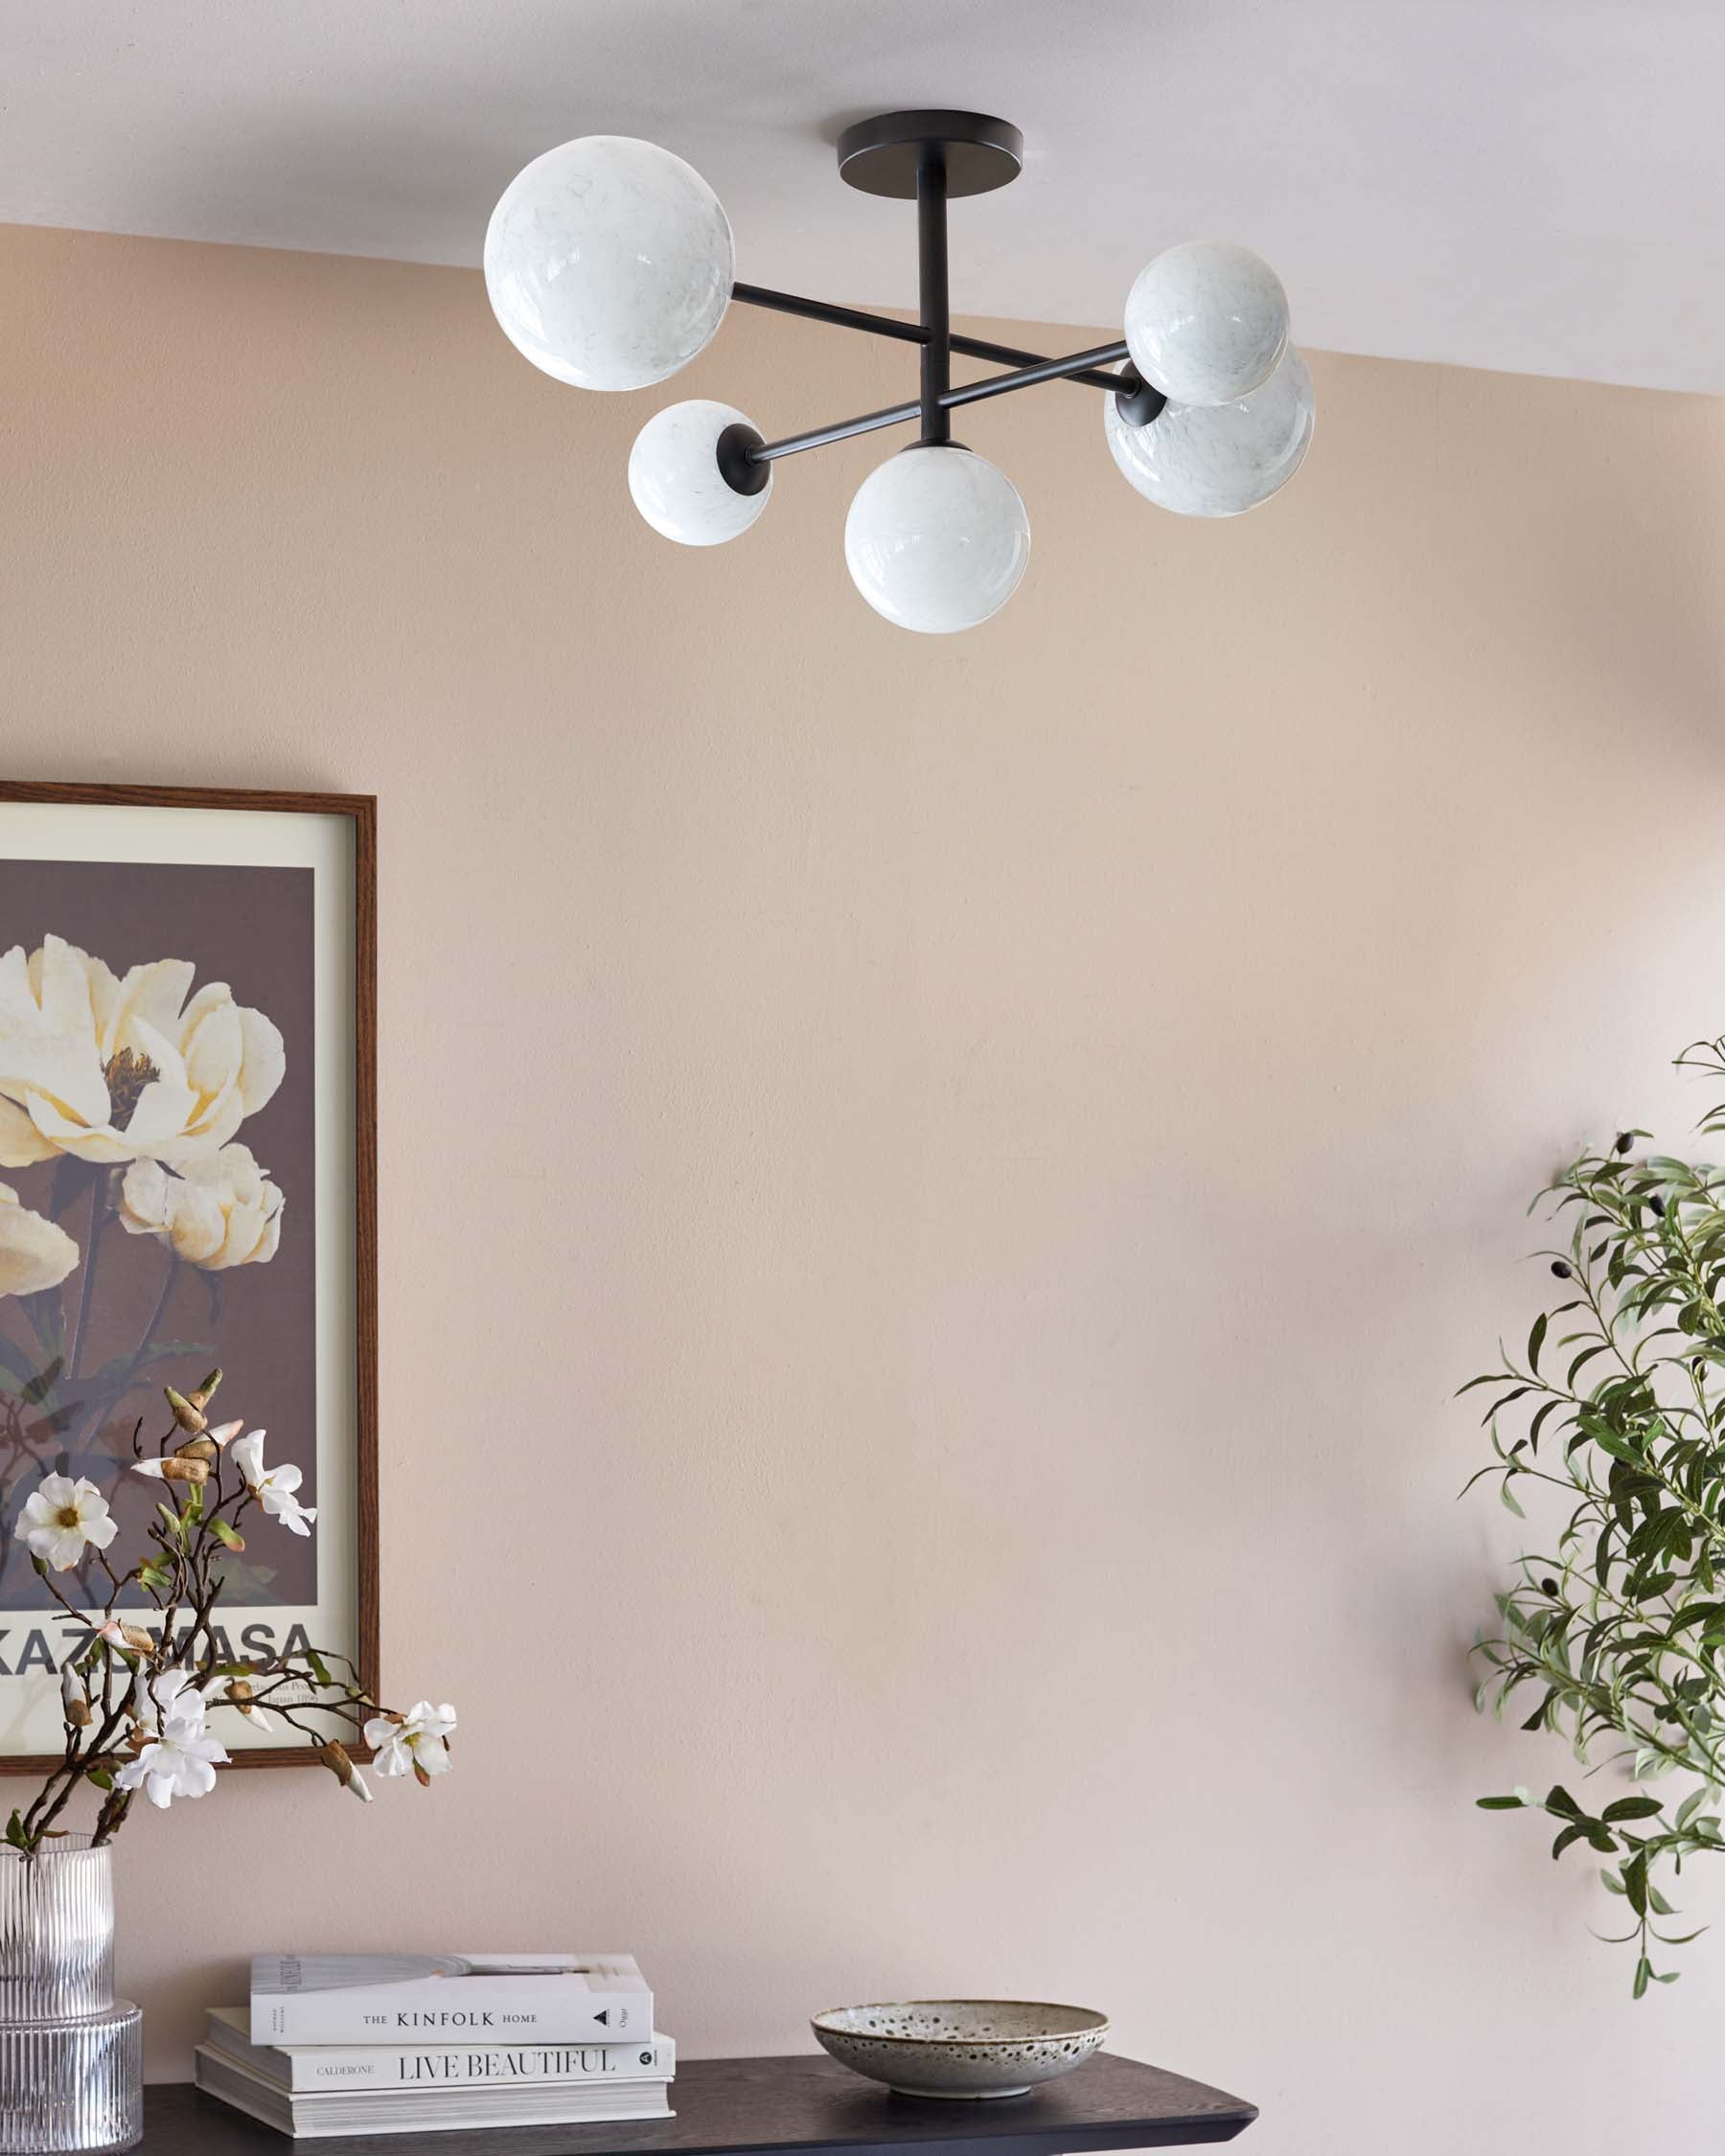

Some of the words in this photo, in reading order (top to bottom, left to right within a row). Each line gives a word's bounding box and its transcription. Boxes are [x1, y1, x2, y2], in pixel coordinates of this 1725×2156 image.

[363, 2015, 388, 2025] THE
[397, 2012, 494, 2027] KINFOLK
[502, 2014, 538, 2024] HOME
[316, 2065, 375, 2076] CALDERONE
[399, 2055, 459, 2080] LIVE
[467, 2049, 616, 2077] BEAUTIFUL
